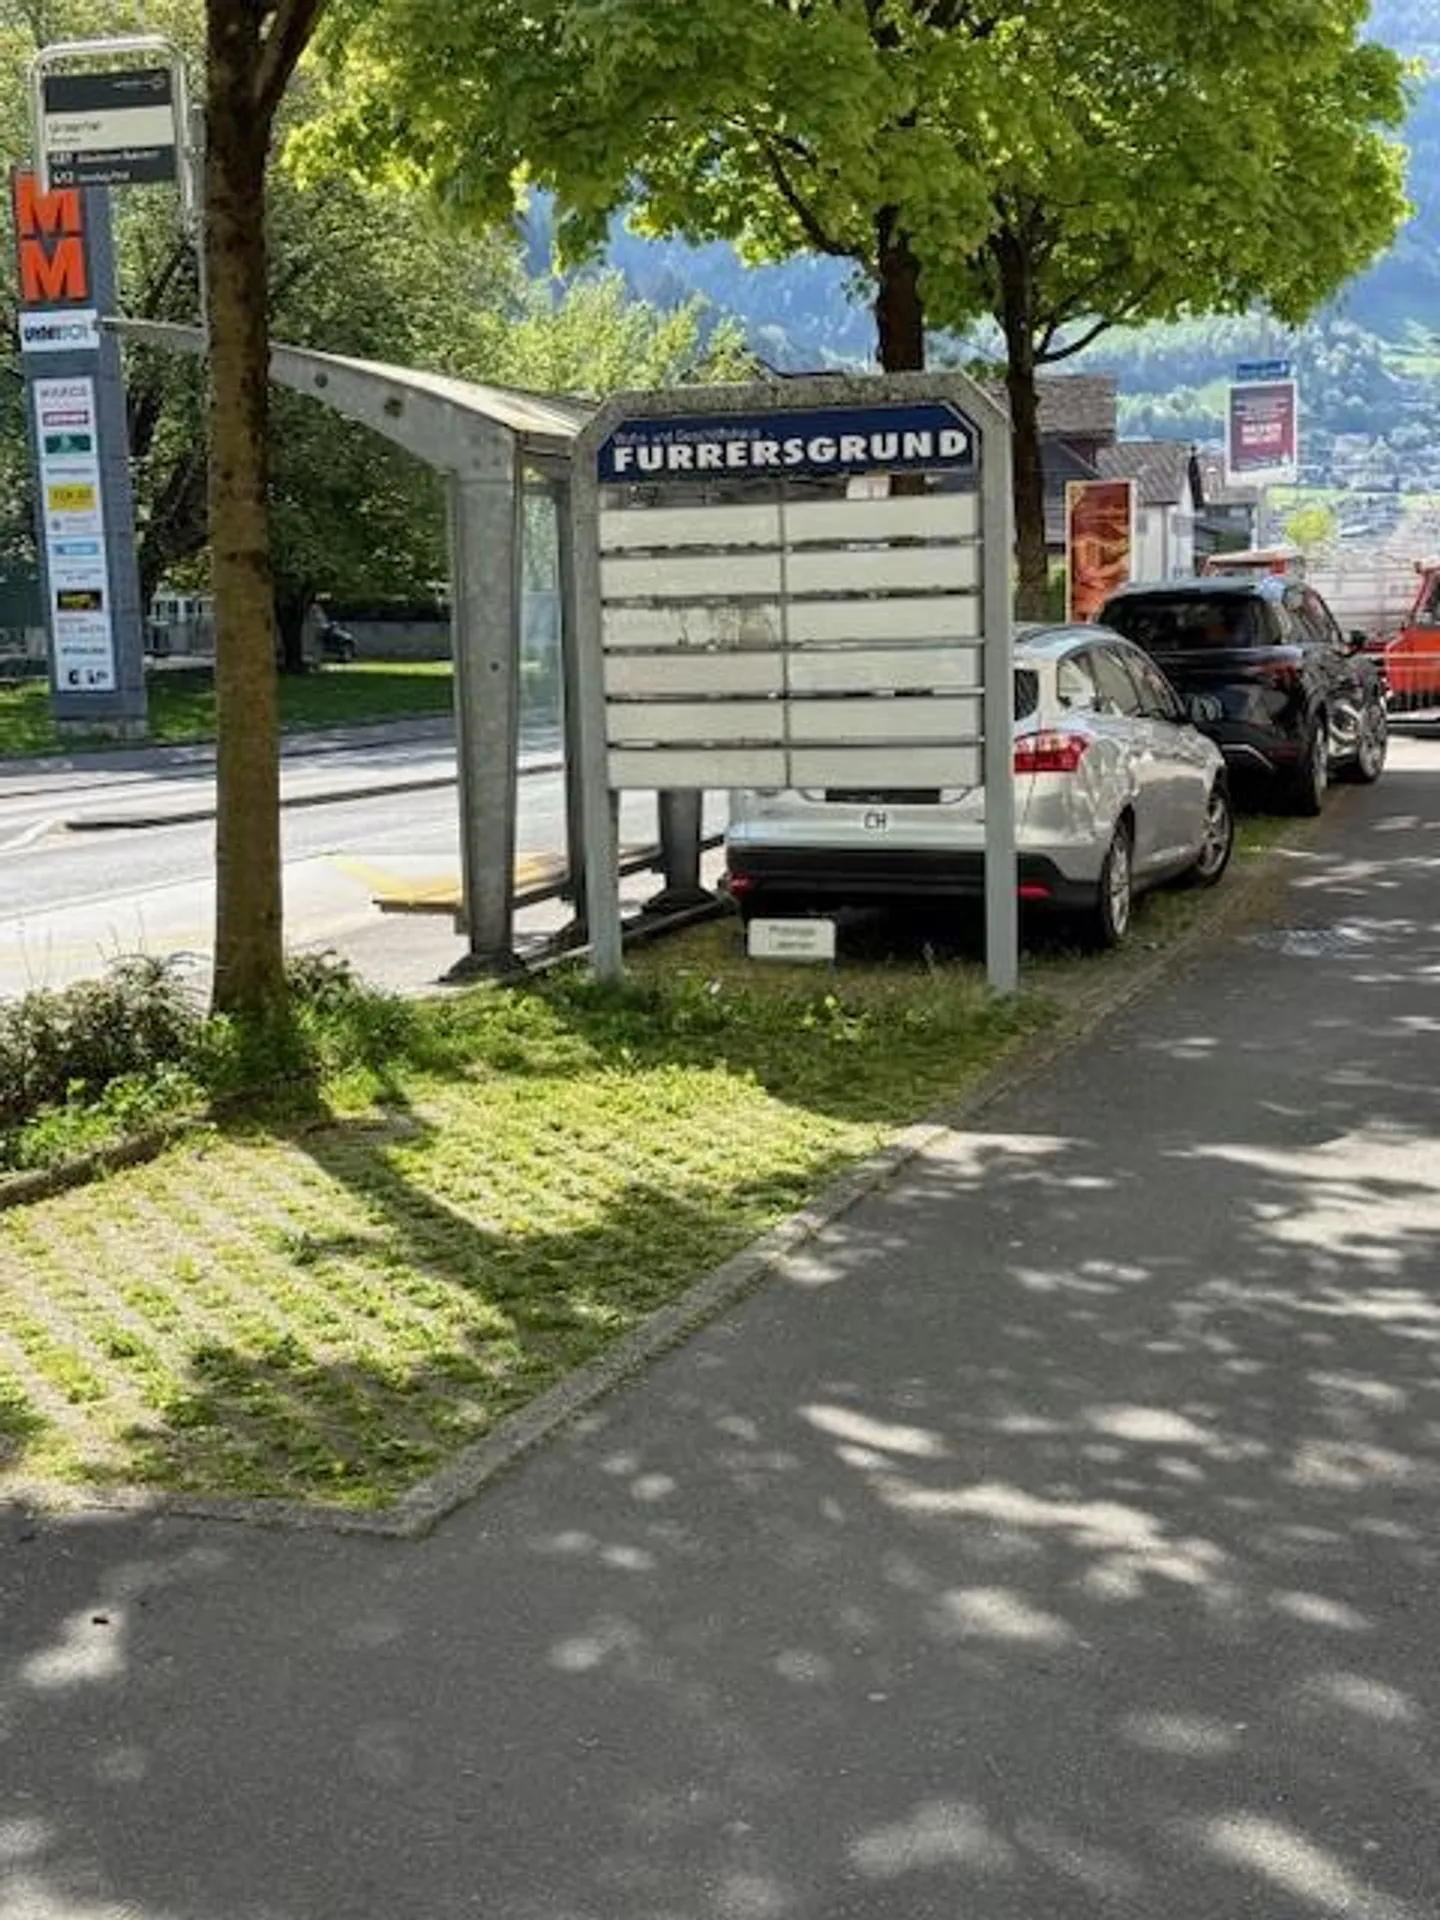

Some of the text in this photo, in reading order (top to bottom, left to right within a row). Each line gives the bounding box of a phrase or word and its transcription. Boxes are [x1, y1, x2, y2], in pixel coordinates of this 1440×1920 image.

[20, 237, 87, 301] M
[614, 428, 968, 473] FURRERSGRUND
[864, 811, 886, 829] CH
